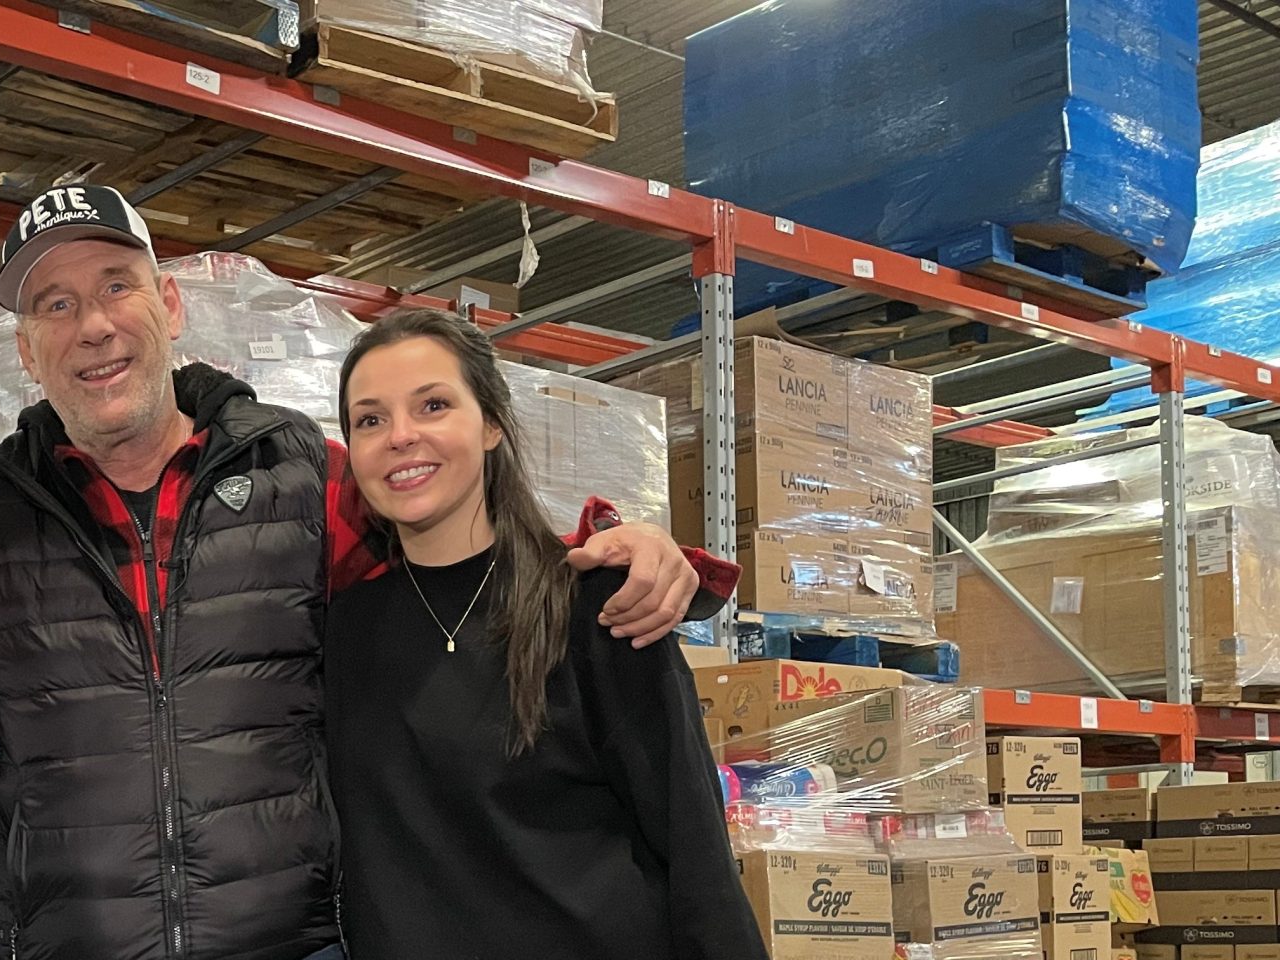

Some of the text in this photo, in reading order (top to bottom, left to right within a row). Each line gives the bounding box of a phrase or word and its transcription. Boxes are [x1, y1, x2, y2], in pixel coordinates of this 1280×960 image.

[19, 187, 92, 241] PETE
[779, 375, 827, 401] LANCIA
[785, 398, 822, 416] PENNINE
[870, 394, 914, 418] LANCIA
[781, 470, 829, 495] LANCIA
[870, 486, 914, 511] LANCIA
[781, 664, 842, 701] Dole
[1026, 764, 1058, 792] Eggo
[1215, 822, 1251, 832] TOSSIMO
[807, 878, 853, 918] Eggo
[963, 882, 1005, 919] Eggo
[1070, 882, 1094, 910] Eggo
